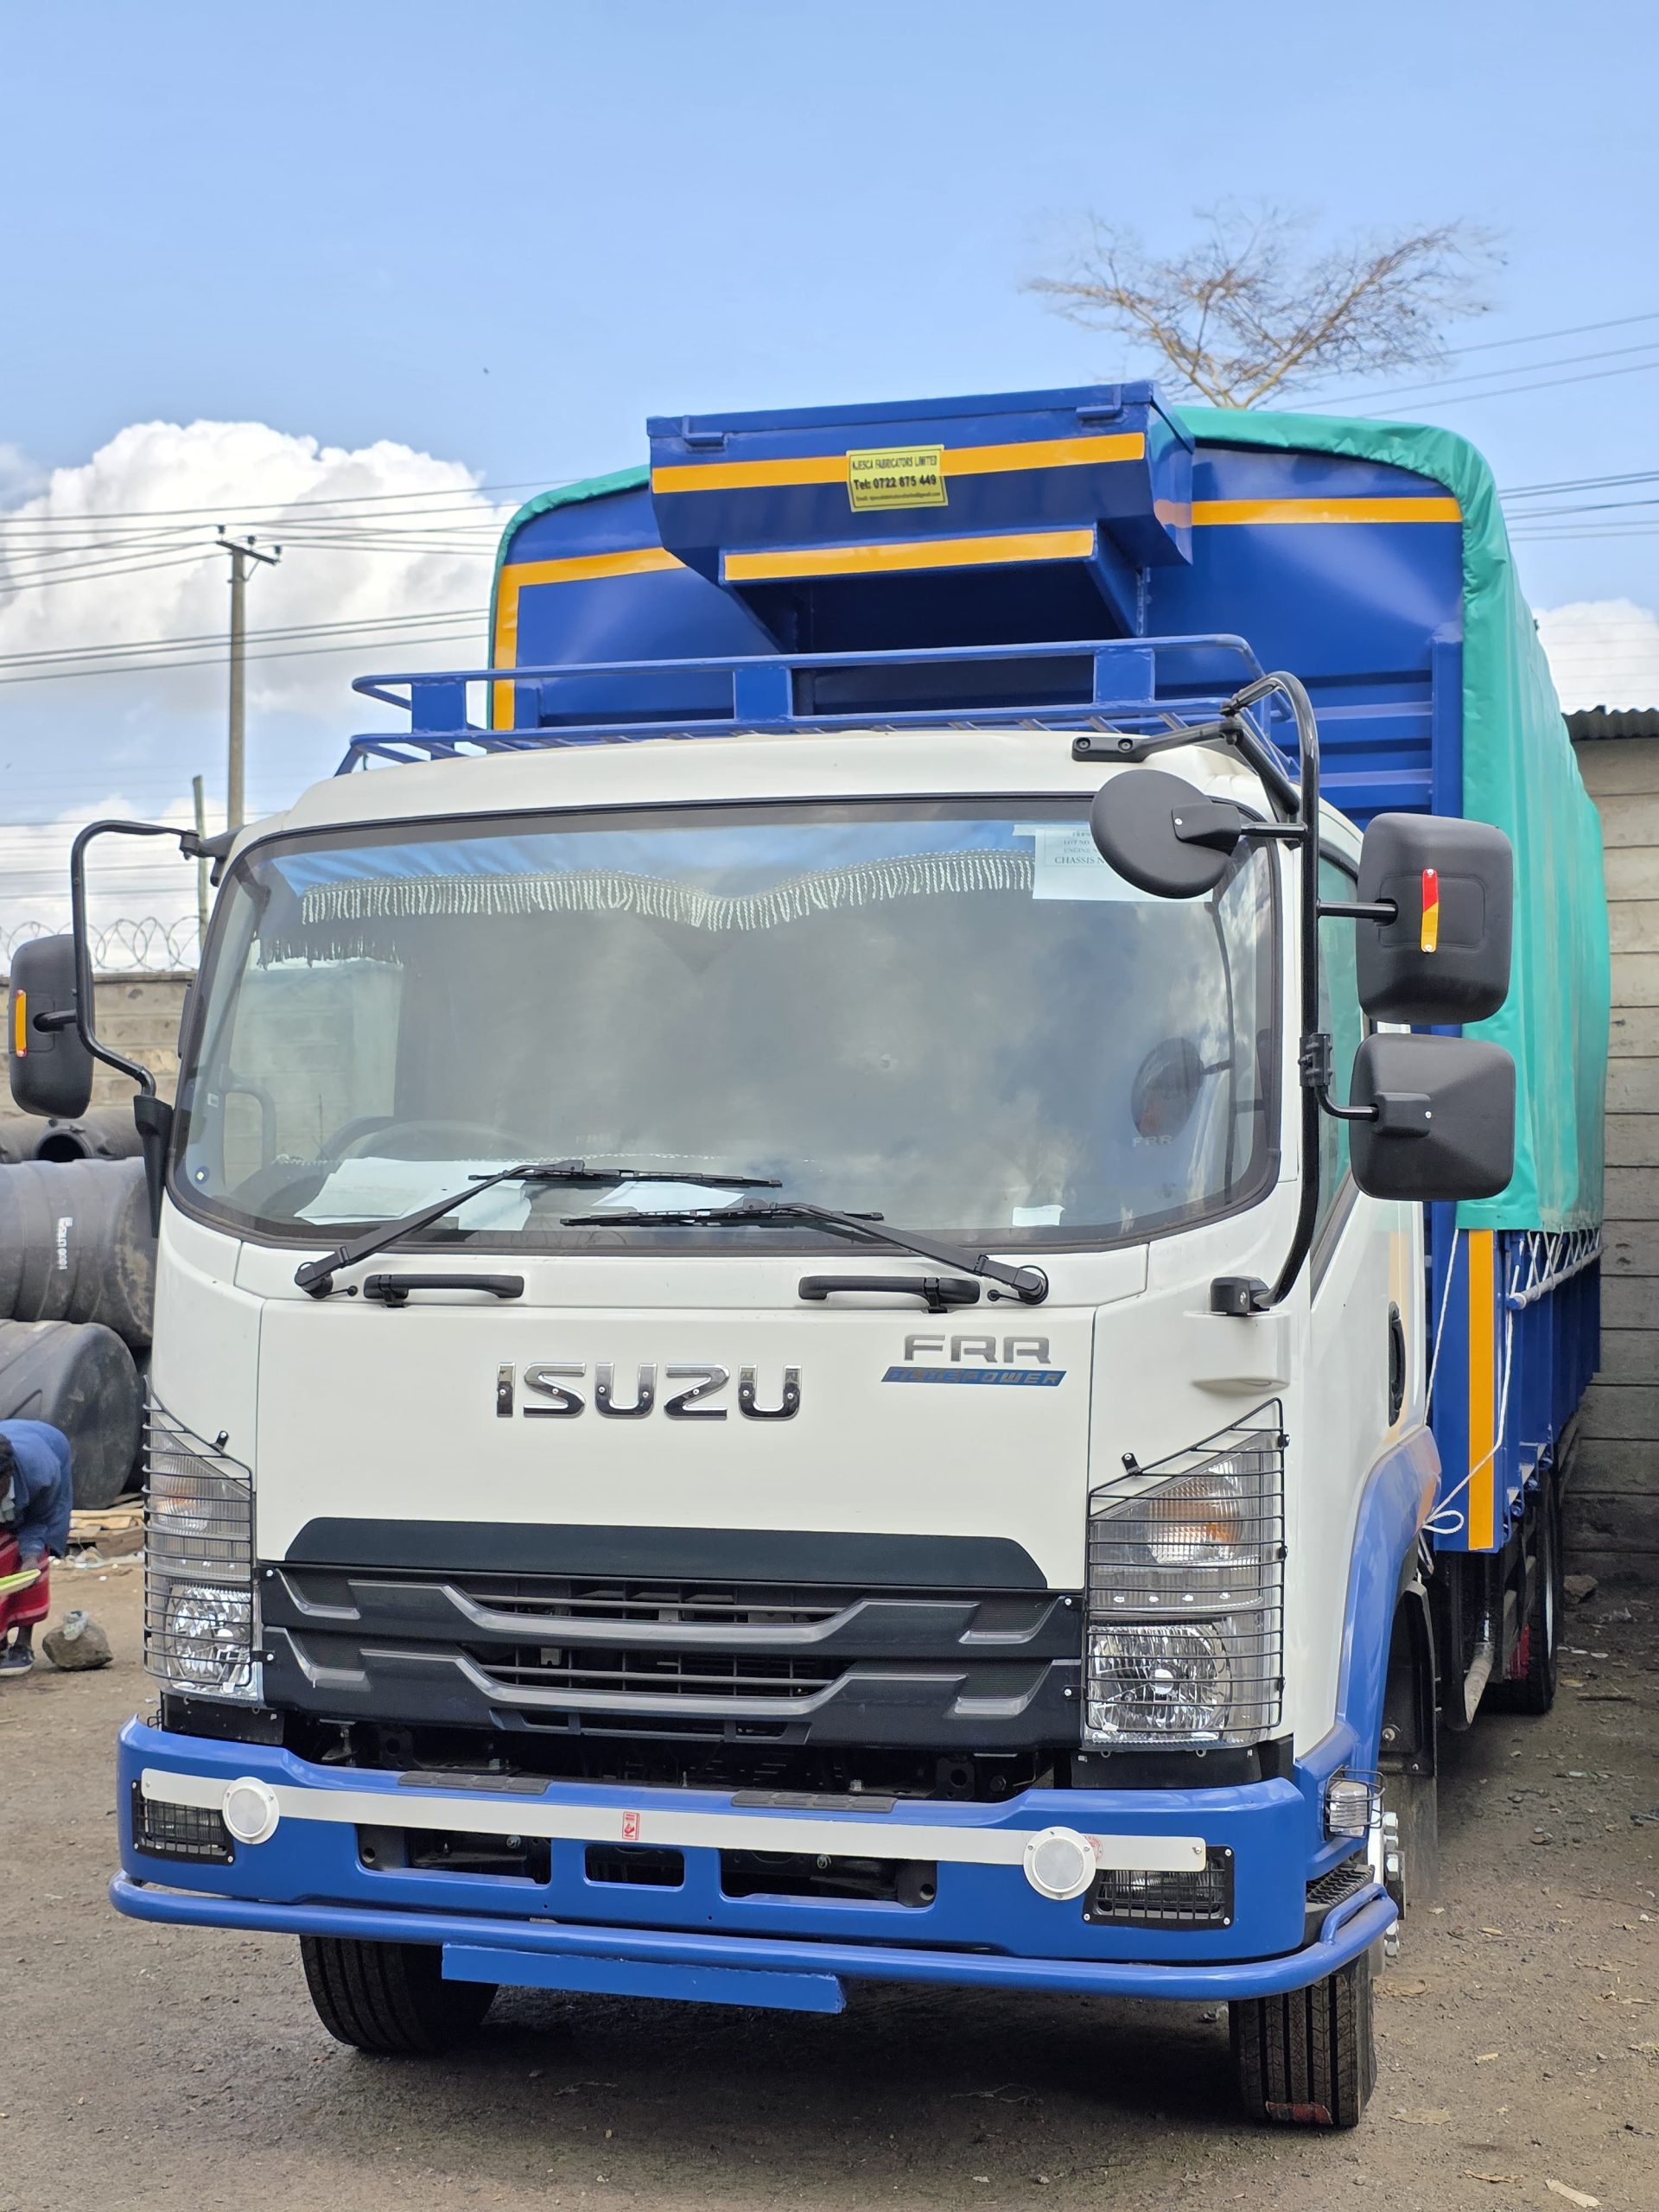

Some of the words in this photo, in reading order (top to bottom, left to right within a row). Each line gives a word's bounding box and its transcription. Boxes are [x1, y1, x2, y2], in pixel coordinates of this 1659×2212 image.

[915, 455, 938, 467] LIMITED
[873, 477, 897, 489] 0722
[899, 476, 917, 487] 875
[919, 474, 937, 486] 449
[904, 1334, 1052, 1364] FRR
[496, 1362, 801, 1421] ISUZU
